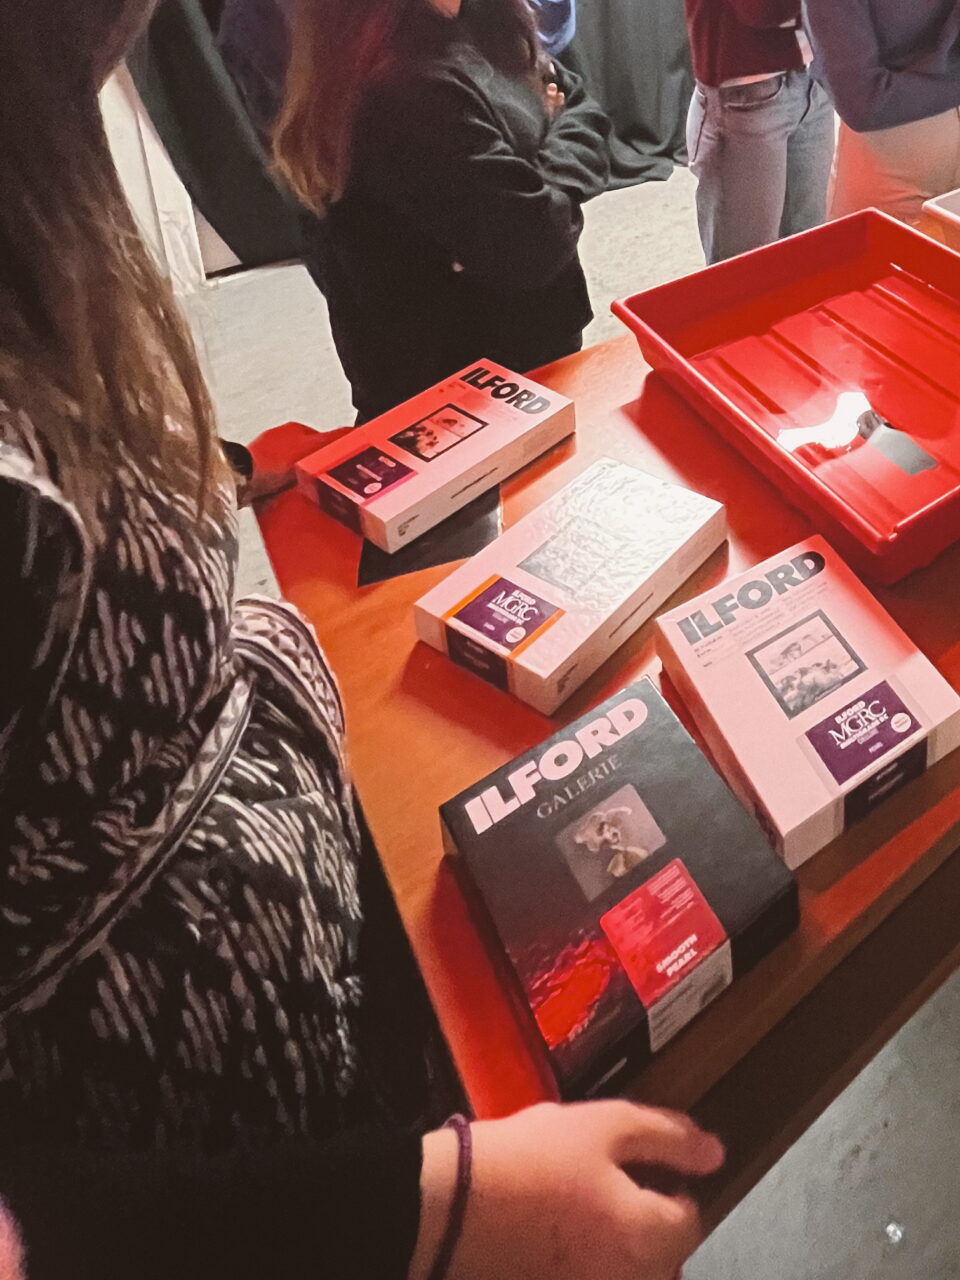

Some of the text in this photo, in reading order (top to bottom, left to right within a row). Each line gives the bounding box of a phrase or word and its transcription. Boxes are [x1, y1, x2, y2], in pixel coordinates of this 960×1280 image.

[459, 367, 551, 414] ILFORD
[491, 591, 539, 621] MGRC
[677, 551, 825, 645] ILFORD
[828, 700, 887, 746] MGRC
[464, 698, 648, 835] ILFORD
[536, 754, 623, 819] GALERIE
